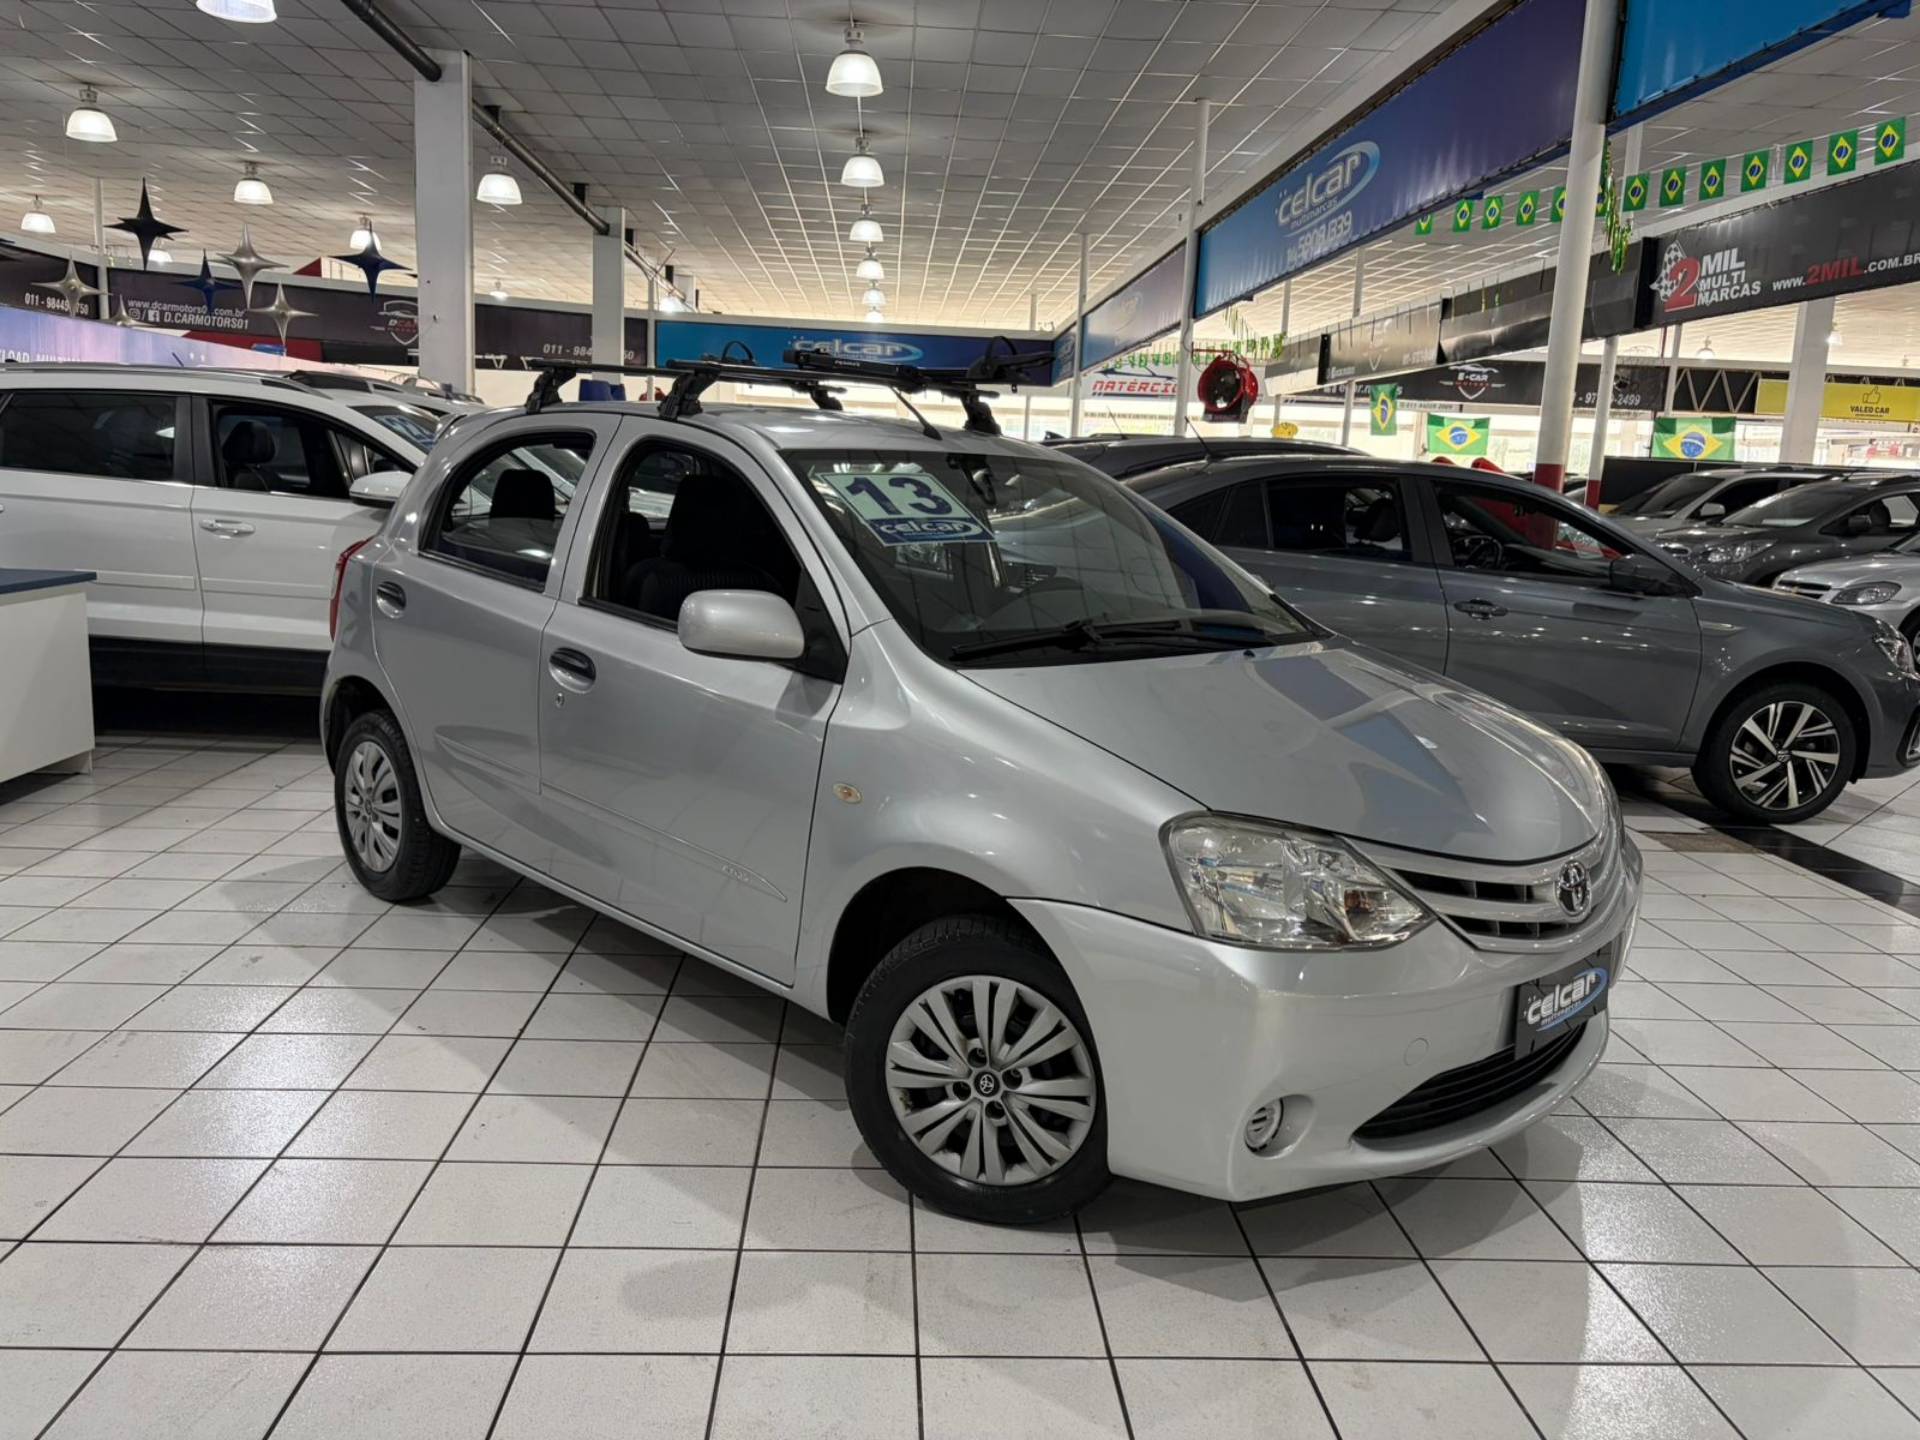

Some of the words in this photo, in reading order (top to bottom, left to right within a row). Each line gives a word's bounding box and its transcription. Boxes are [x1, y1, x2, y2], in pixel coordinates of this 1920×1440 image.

[1278, 152, 1361, 226] celcar
[1664, 255, 1701, 313] 2
[1701, 247, 1746, 276] MIL
[1699, 270, 1746, 292] MULTI
[24, 292, 40, 306] 011
[1697, 281, 1762, 306] MARCAS
[127, 300, 244, 317] www.dcarmotors0.com.br
[543, 343, 563, 355] 011
[845, 477, 953, 516] 13
[880, 520, 966, 534] celcar
[1528, 971, 1597, 1025] celcar
